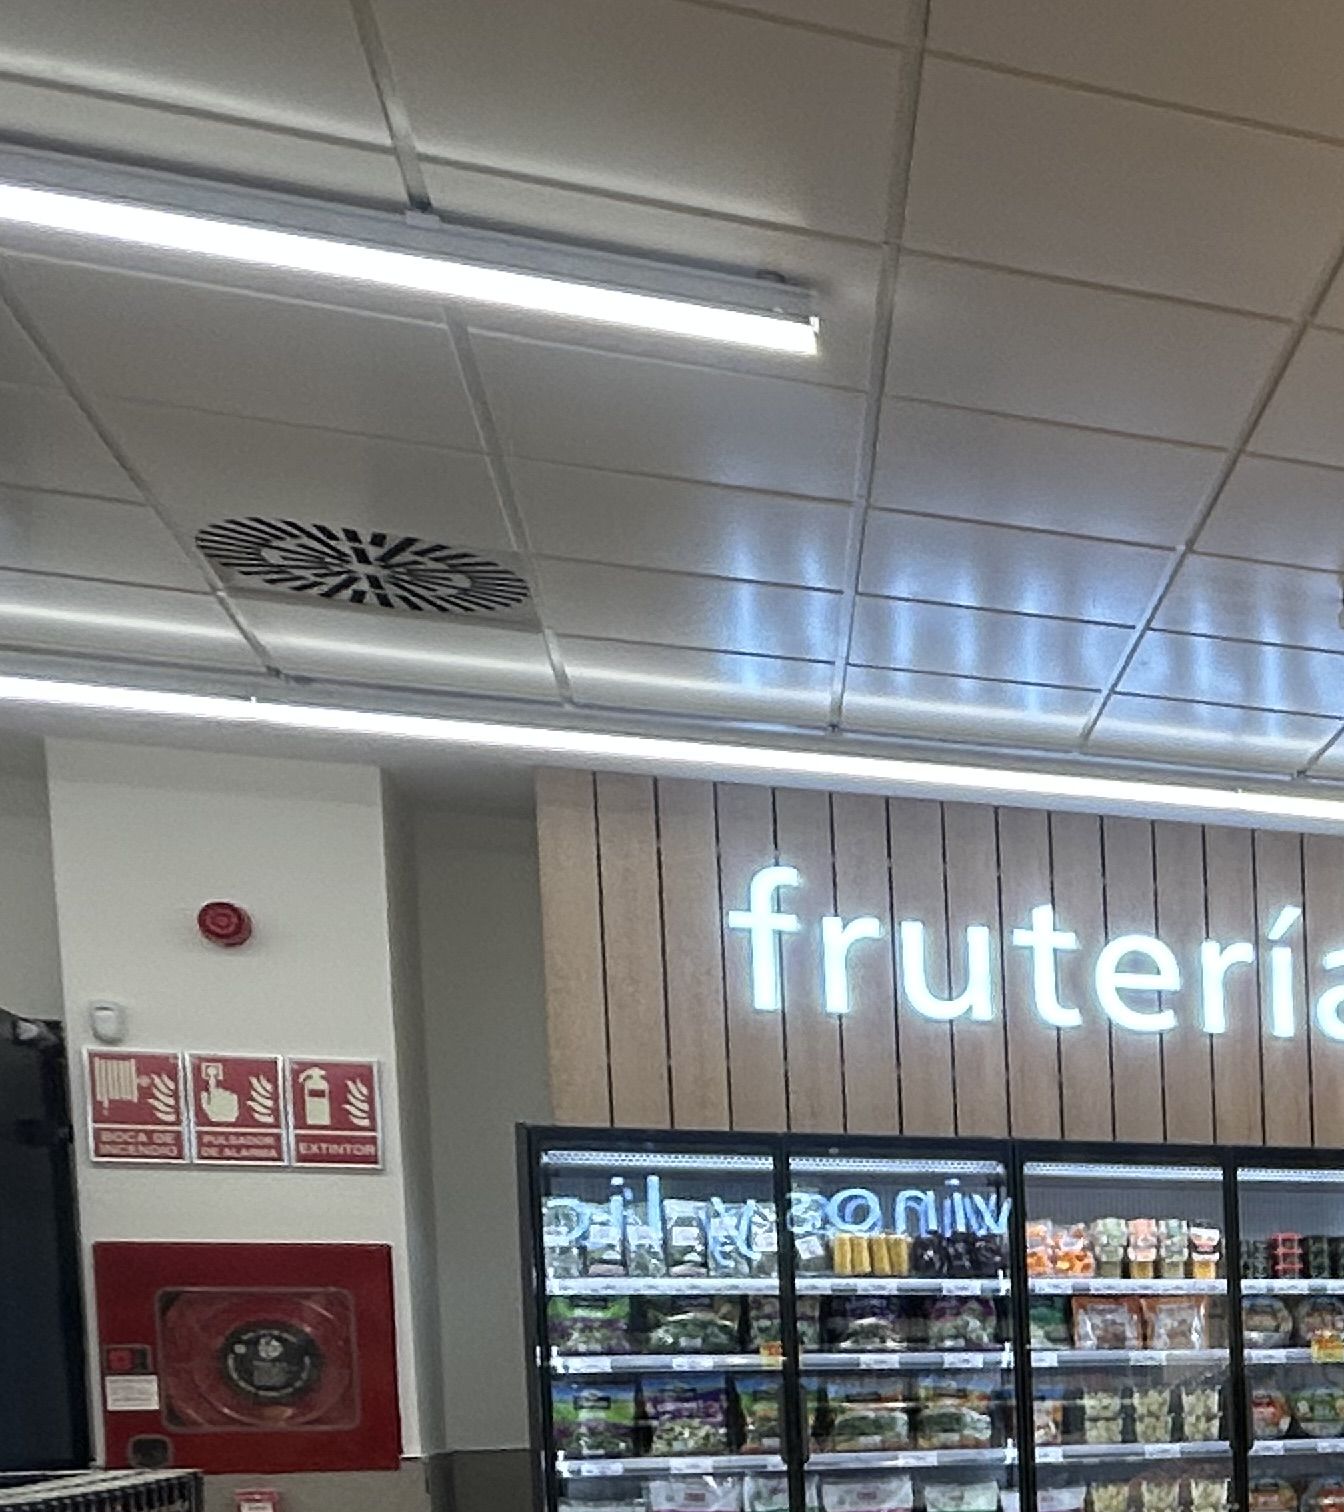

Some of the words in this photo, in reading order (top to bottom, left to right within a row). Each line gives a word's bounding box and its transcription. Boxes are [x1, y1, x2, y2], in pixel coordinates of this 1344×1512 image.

[100, 1130, 148, 1143] BOCA
[152, 1131, 176, 1144] DE
[202, 1134, 276, 1146] PULSADOR
[98, 1143, 178, 1157] INCENDIO
[200, 1146, 220, 1158] DE
[222, 1148, 278, 1159] ALARMA
[299, 1142, 377, 1157] EXTINTOR
